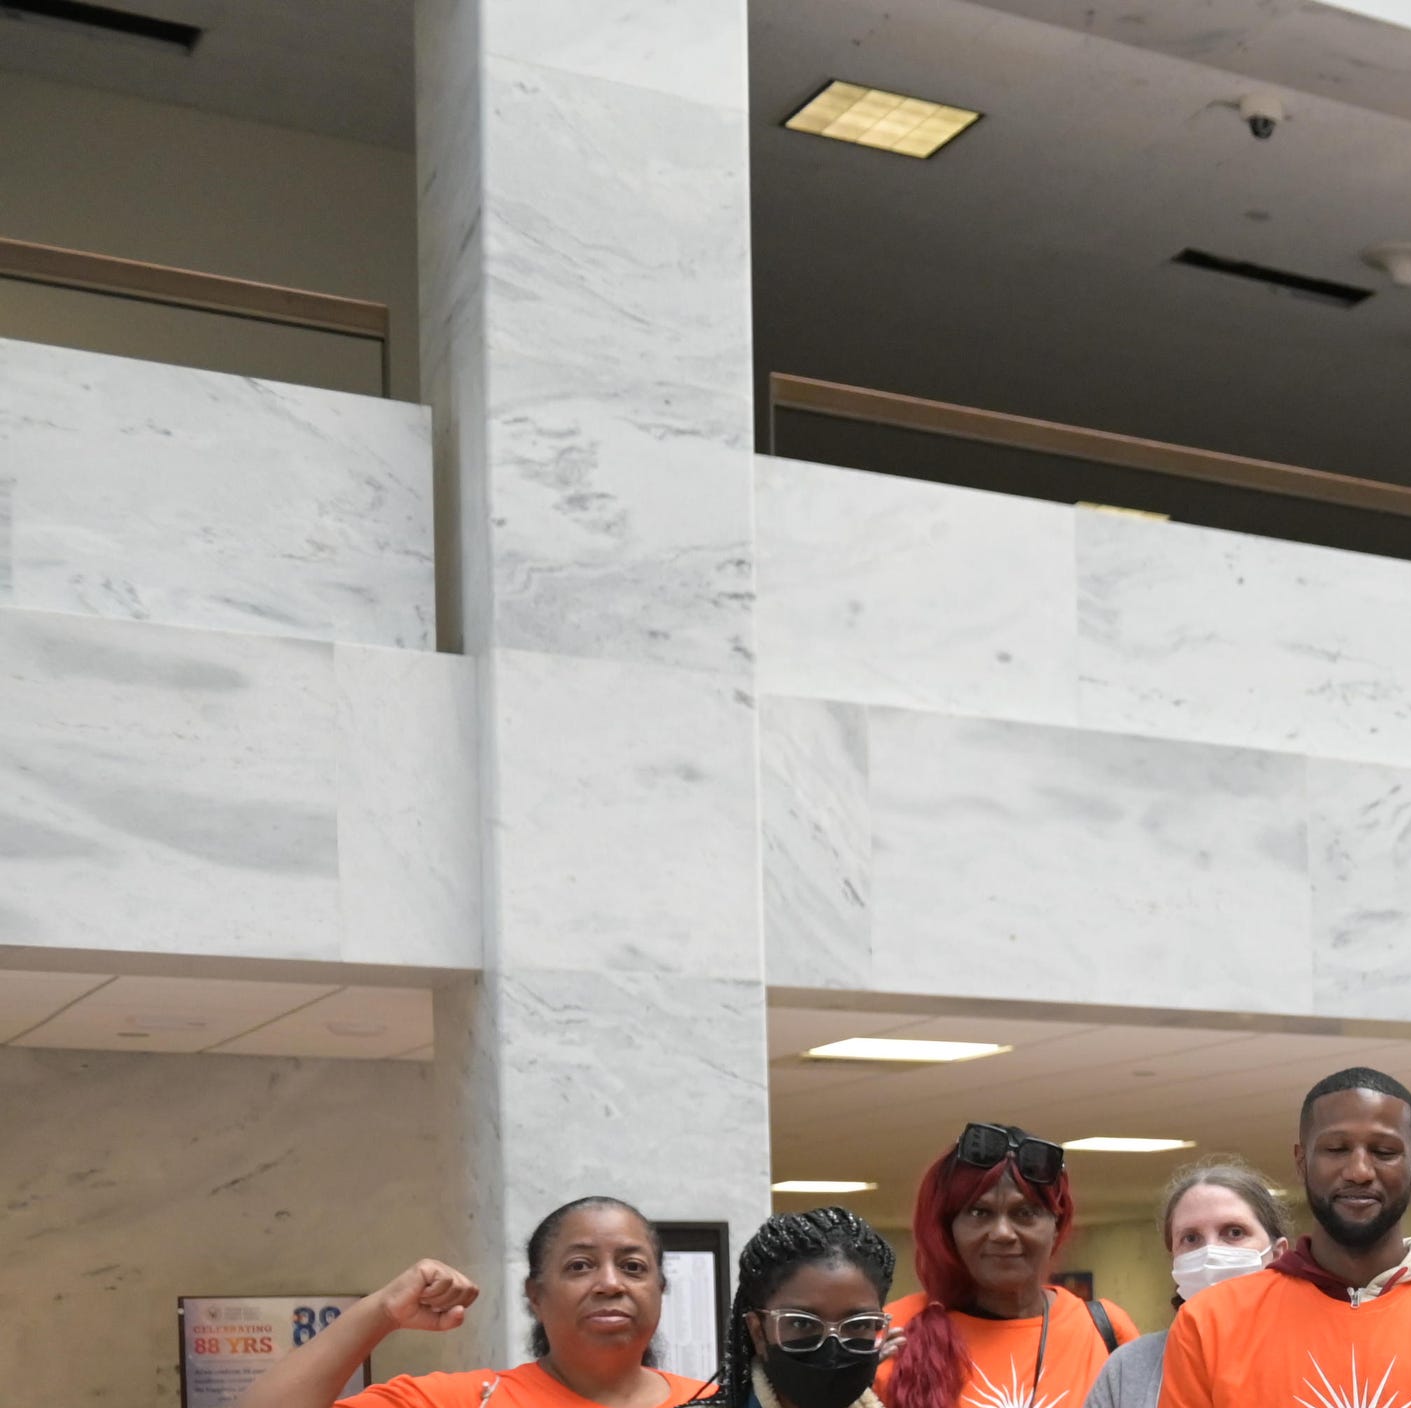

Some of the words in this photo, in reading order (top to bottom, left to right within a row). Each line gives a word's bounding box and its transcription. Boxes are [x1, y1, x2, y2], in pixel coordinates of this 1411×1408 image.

[193, 1325, 272, 1334] CELEBRATING
[195, 1338, 220, 1354] 88
[224, 1336, 273, 1353] YRS
